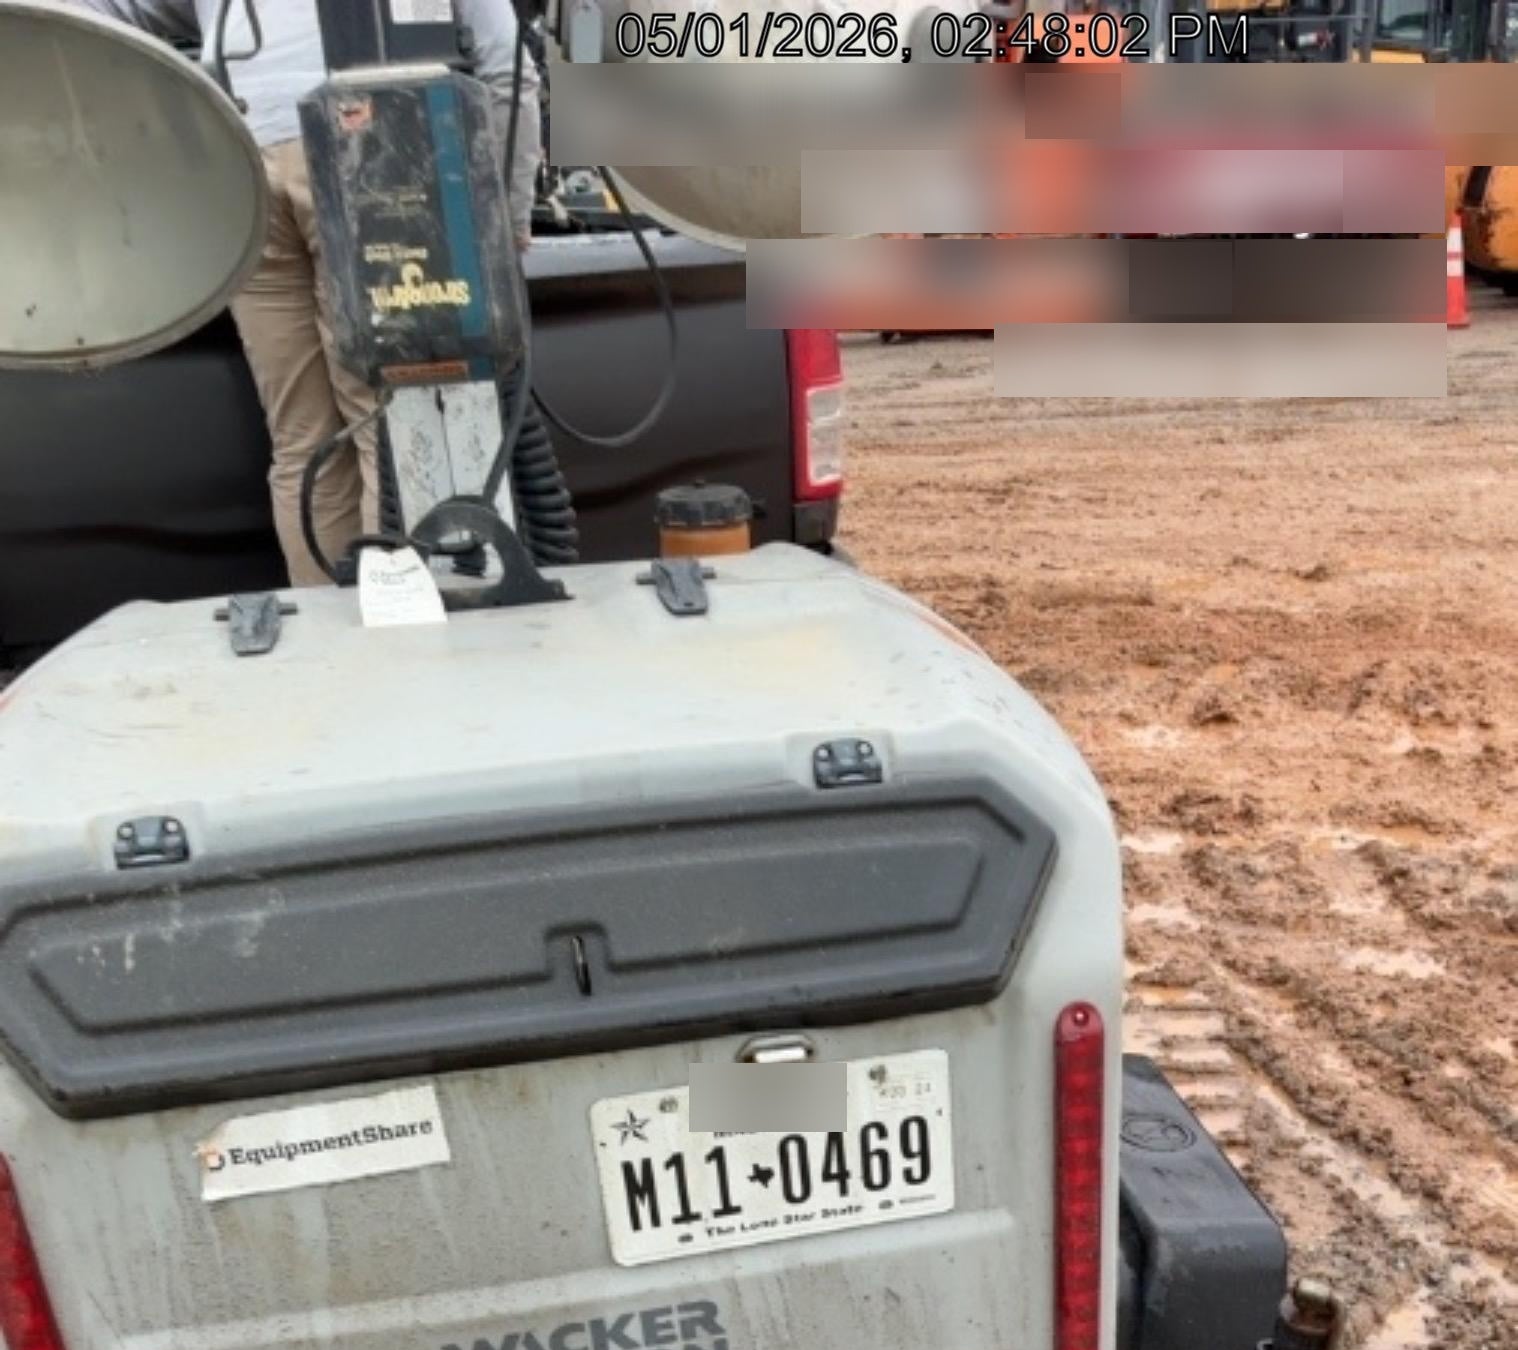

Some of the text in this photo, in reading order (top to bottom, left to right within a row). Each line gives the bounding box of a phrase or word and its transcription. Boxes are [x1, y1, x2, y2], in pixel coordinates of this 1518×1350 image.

[228, 1119, 433, 1165] EquipmentShare
[705, 1204, 863, 1237] The Lone Star State
